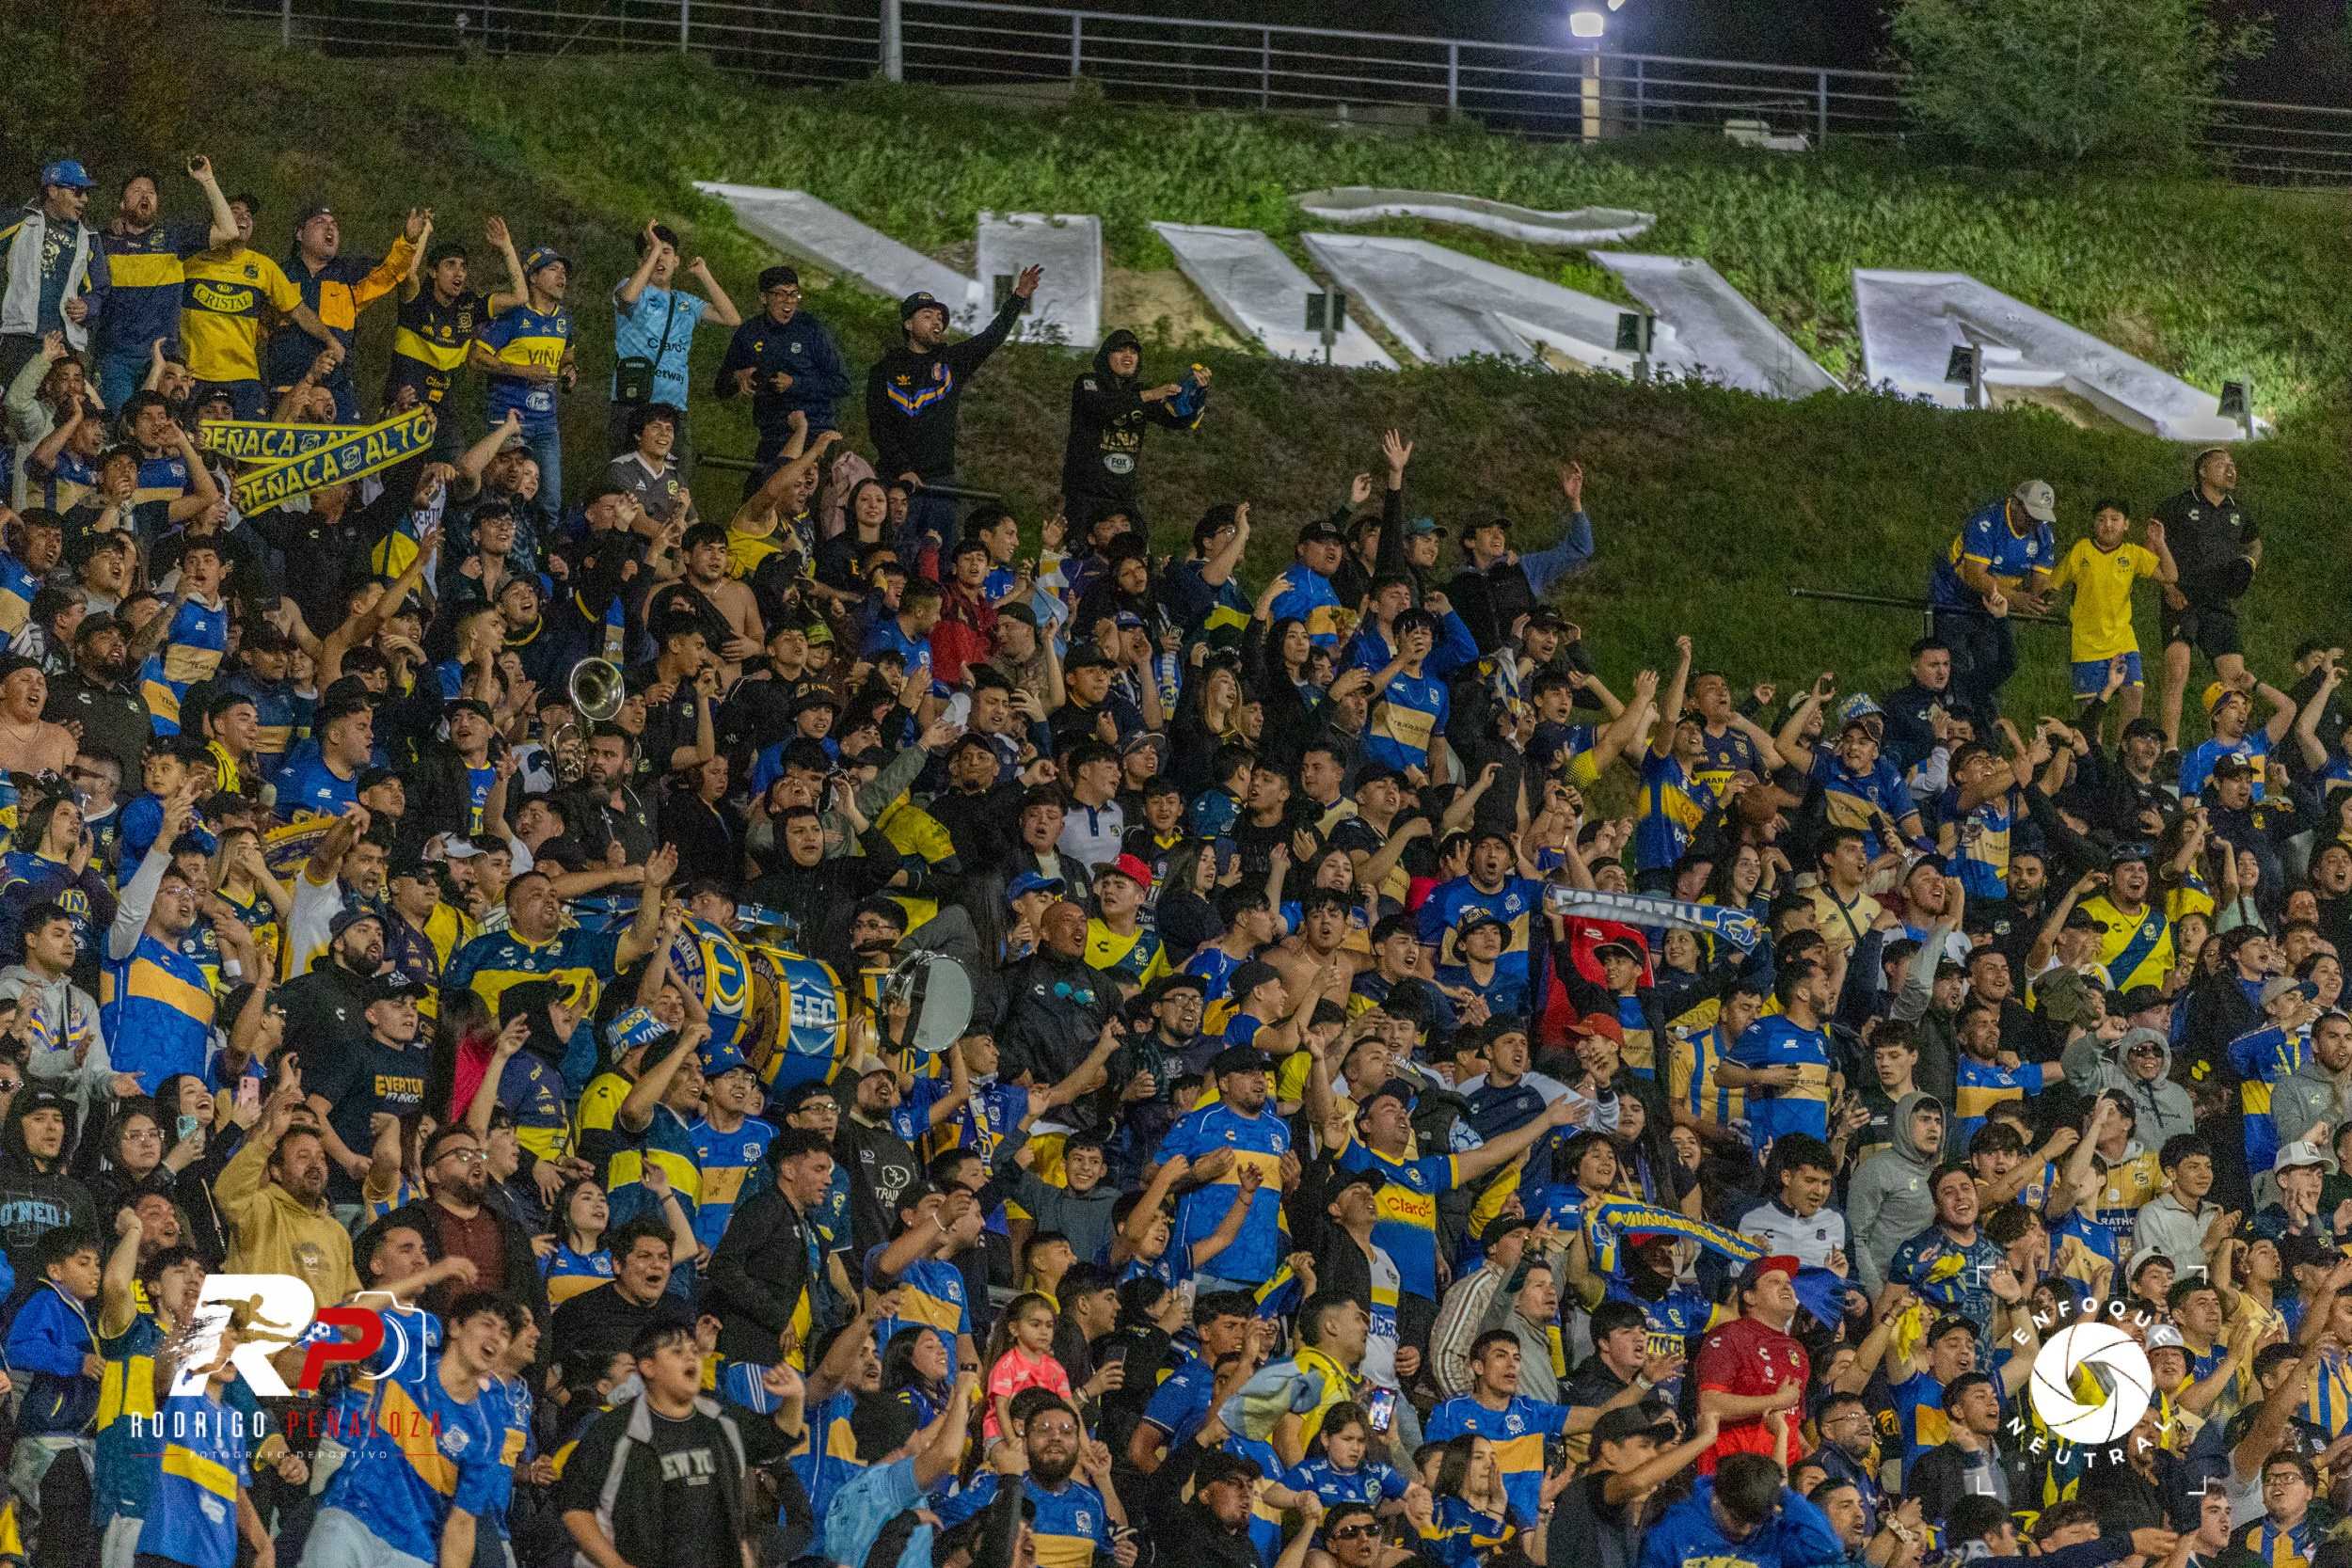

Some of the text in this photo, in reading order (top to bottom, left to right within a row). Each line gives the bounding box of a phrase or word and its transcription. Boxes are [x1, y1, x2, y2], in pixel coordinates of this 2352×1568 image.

[197, 286, 251, 311] CRISTAL
[692, 182, 2270, 440] VIÑA
[647, 338, 683, 352] Caro
[655, 369, 684, 385] etway
[365, 416, 431, 465] ALTO
[1111, 457, 1128, 467] FOX
[789, 991, 836, 1034] EFC
[1387, 1195, 1432, 1218] Claro
